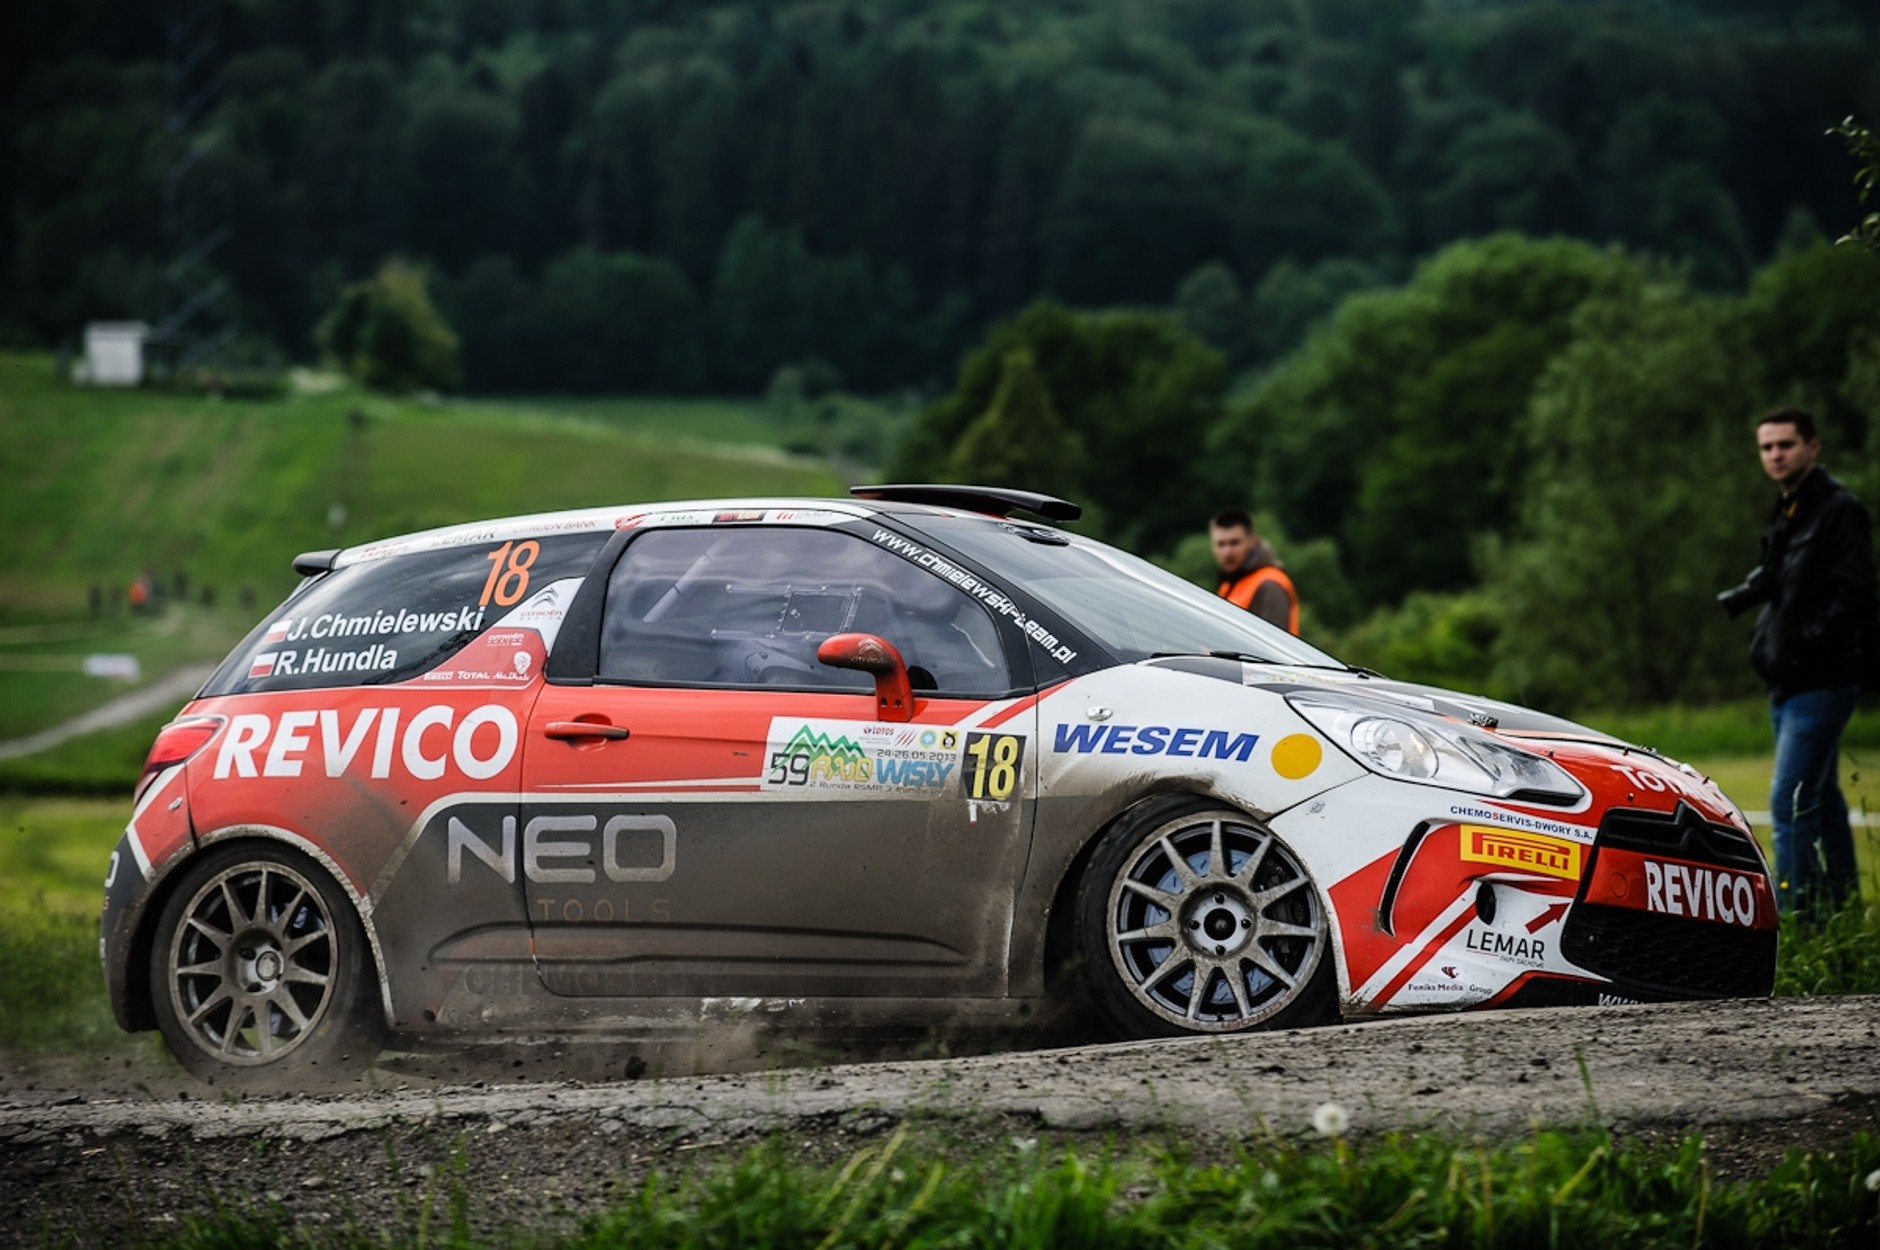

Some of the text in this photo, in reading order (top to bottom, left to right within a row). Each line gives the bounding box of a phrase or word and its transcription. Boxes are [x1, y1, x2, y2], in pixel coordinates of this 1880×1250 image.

[478, 539, 540, 607] 18
[872, 529, 1078, 664] www.chmielewski-team.pl
[286, 605, 486, 643] J.Chmielewski
[275, 648, 398, 677] R.Hundla
[457, 670, 490, 680] TOTAL
[213, 704, 519, 781] REVICO
[1053, 723, 1260, 763] WESEM
[768, 752, 811, 786] 59
[968, 734, 1020, 800] 18
[1450, 804, 1594, 840] CHEMOSERVIS-DWORY S.A.
[447, 814, 678, 885] NEO
[1471, 831, 1572, 871] PIRELLI
[537, 898, 673, 925] TOOLS
[1643, 859, 1756, 927] REVICO
[1466, 929, 1546, 961] LEMAR
[1469, 983, 1494, 996] Group
